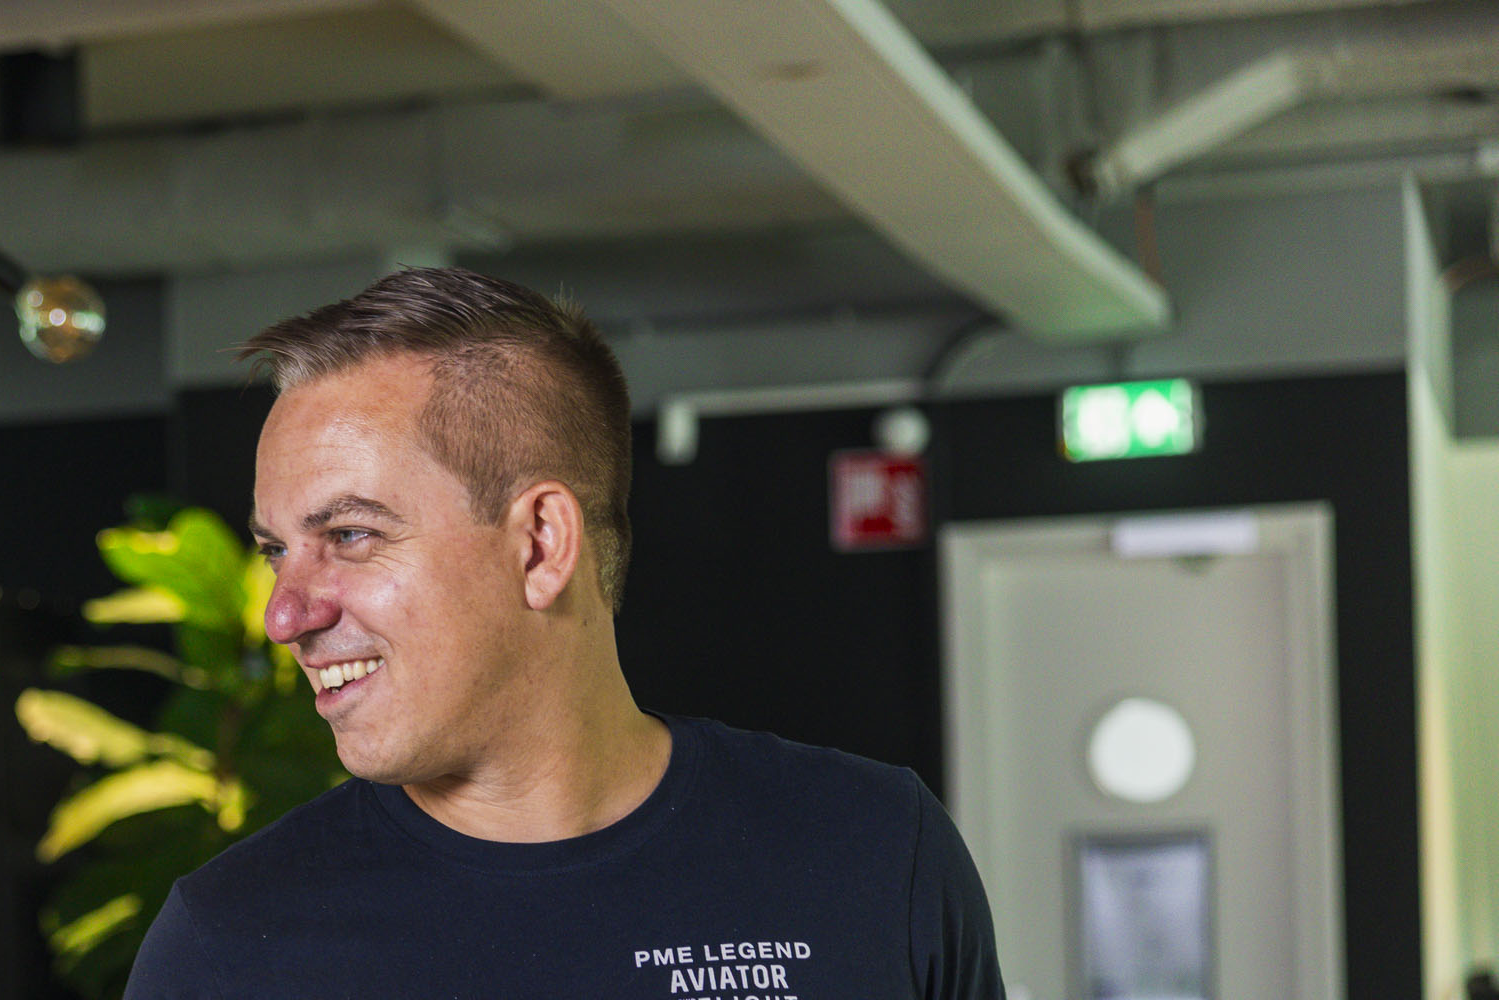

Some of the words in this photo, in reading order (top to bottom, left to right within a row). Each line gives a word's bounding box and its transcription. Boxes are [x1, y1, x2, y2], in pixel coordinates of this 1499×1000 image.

[634, 946, 694, 968] PME
[704, 941, 812, 962] LEGEND
[670, 964, 789, 994] AVIATOR
